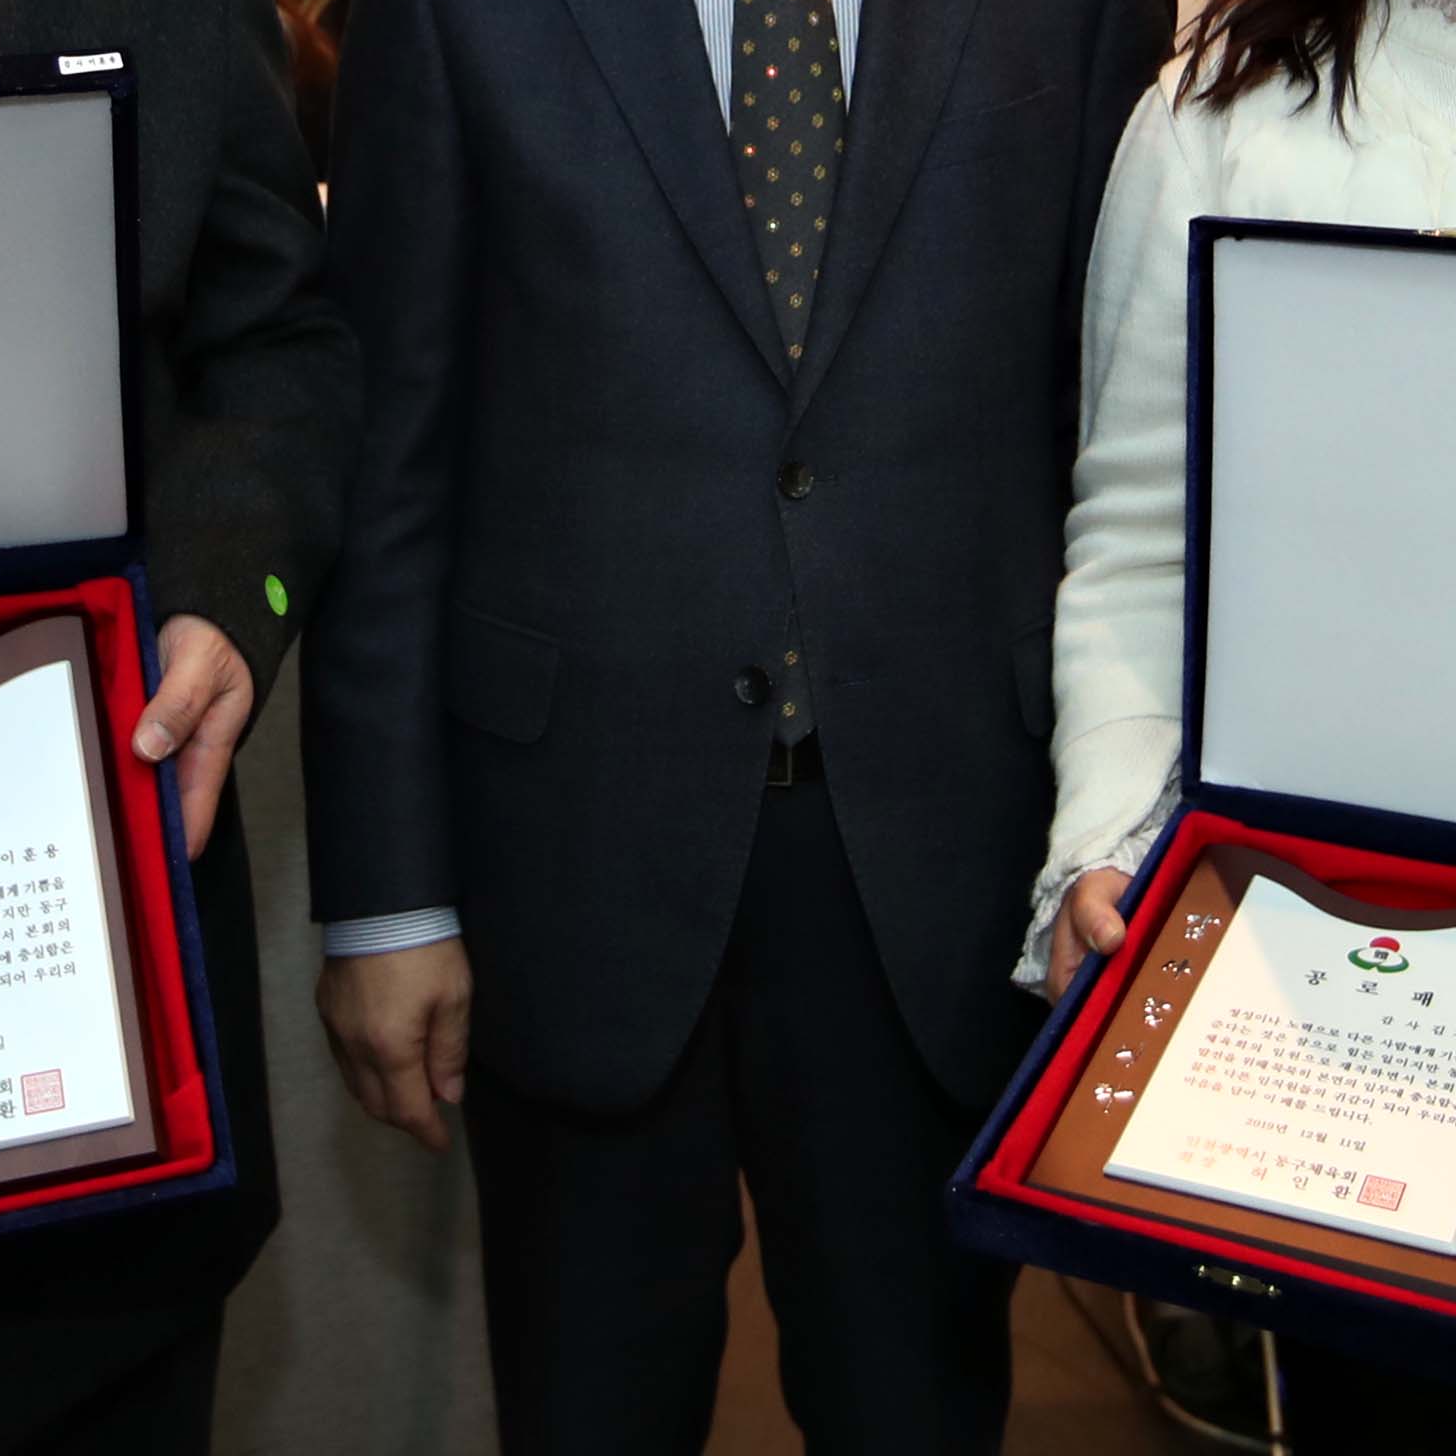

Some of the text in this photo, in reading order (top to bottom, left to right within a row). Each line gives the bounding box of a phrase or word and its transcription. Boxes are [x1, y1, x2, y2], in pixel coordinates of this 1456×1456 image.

[24, 876, 64, 894] 기쁨을
[40, 897, 68, 914] 동구
[25, 918, 71, 938] 본회의
[0, 970, 27, 987] 되어
[34, 961, 76, 982] 우리의
[1304, 969, 1434, 1007] 공로패
